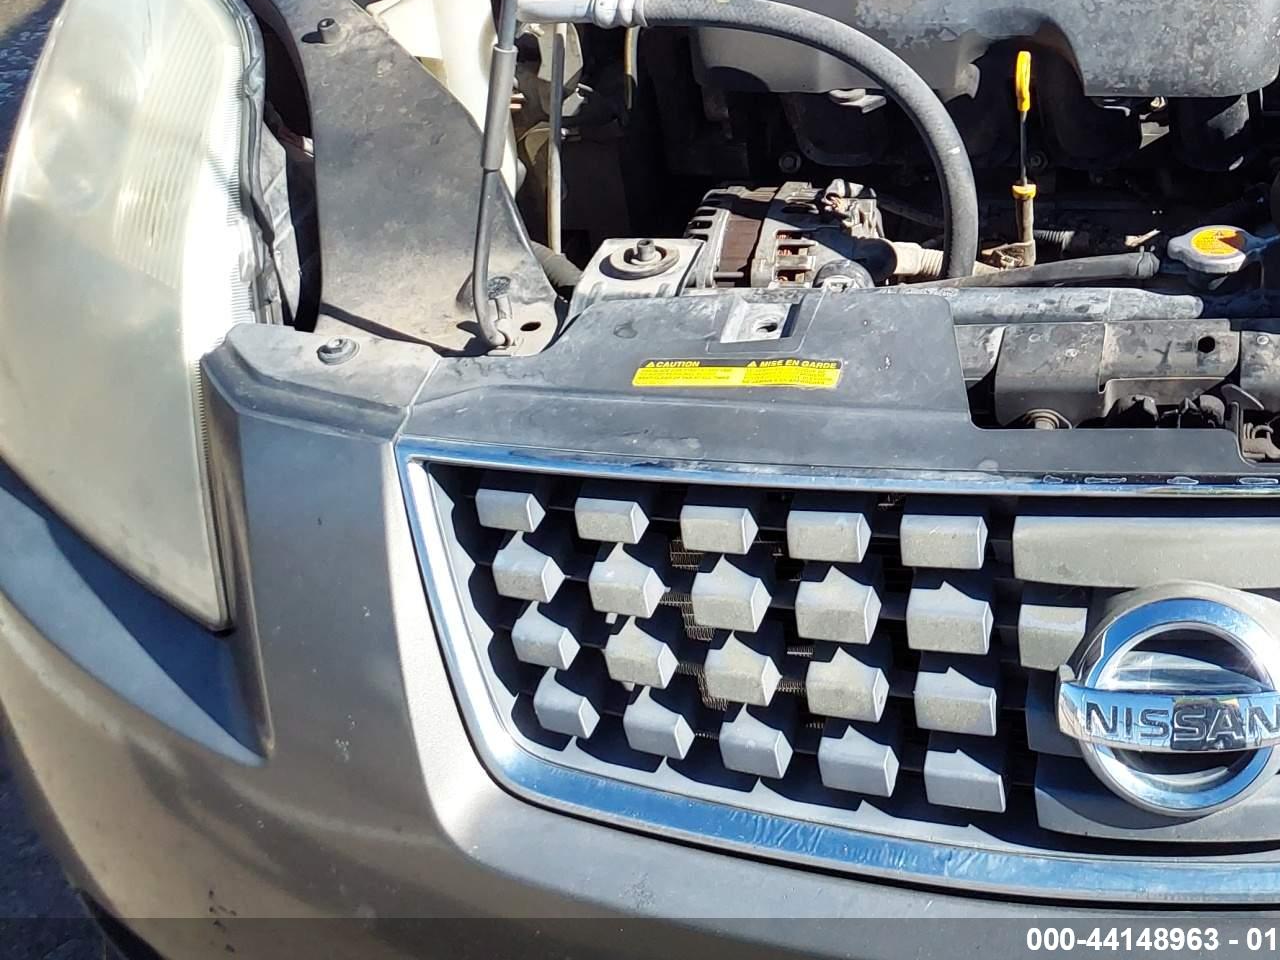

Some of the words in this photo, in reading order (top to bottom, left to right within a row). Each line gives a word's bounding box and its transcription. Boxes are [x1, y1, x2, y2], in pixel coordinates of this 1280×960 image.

[656, 360, 700, 368] CAUTION
[760, 359, 784, 368] MISE
[785, 359, 800, 367] EN
[801, 360, 838, 369] GARDE
